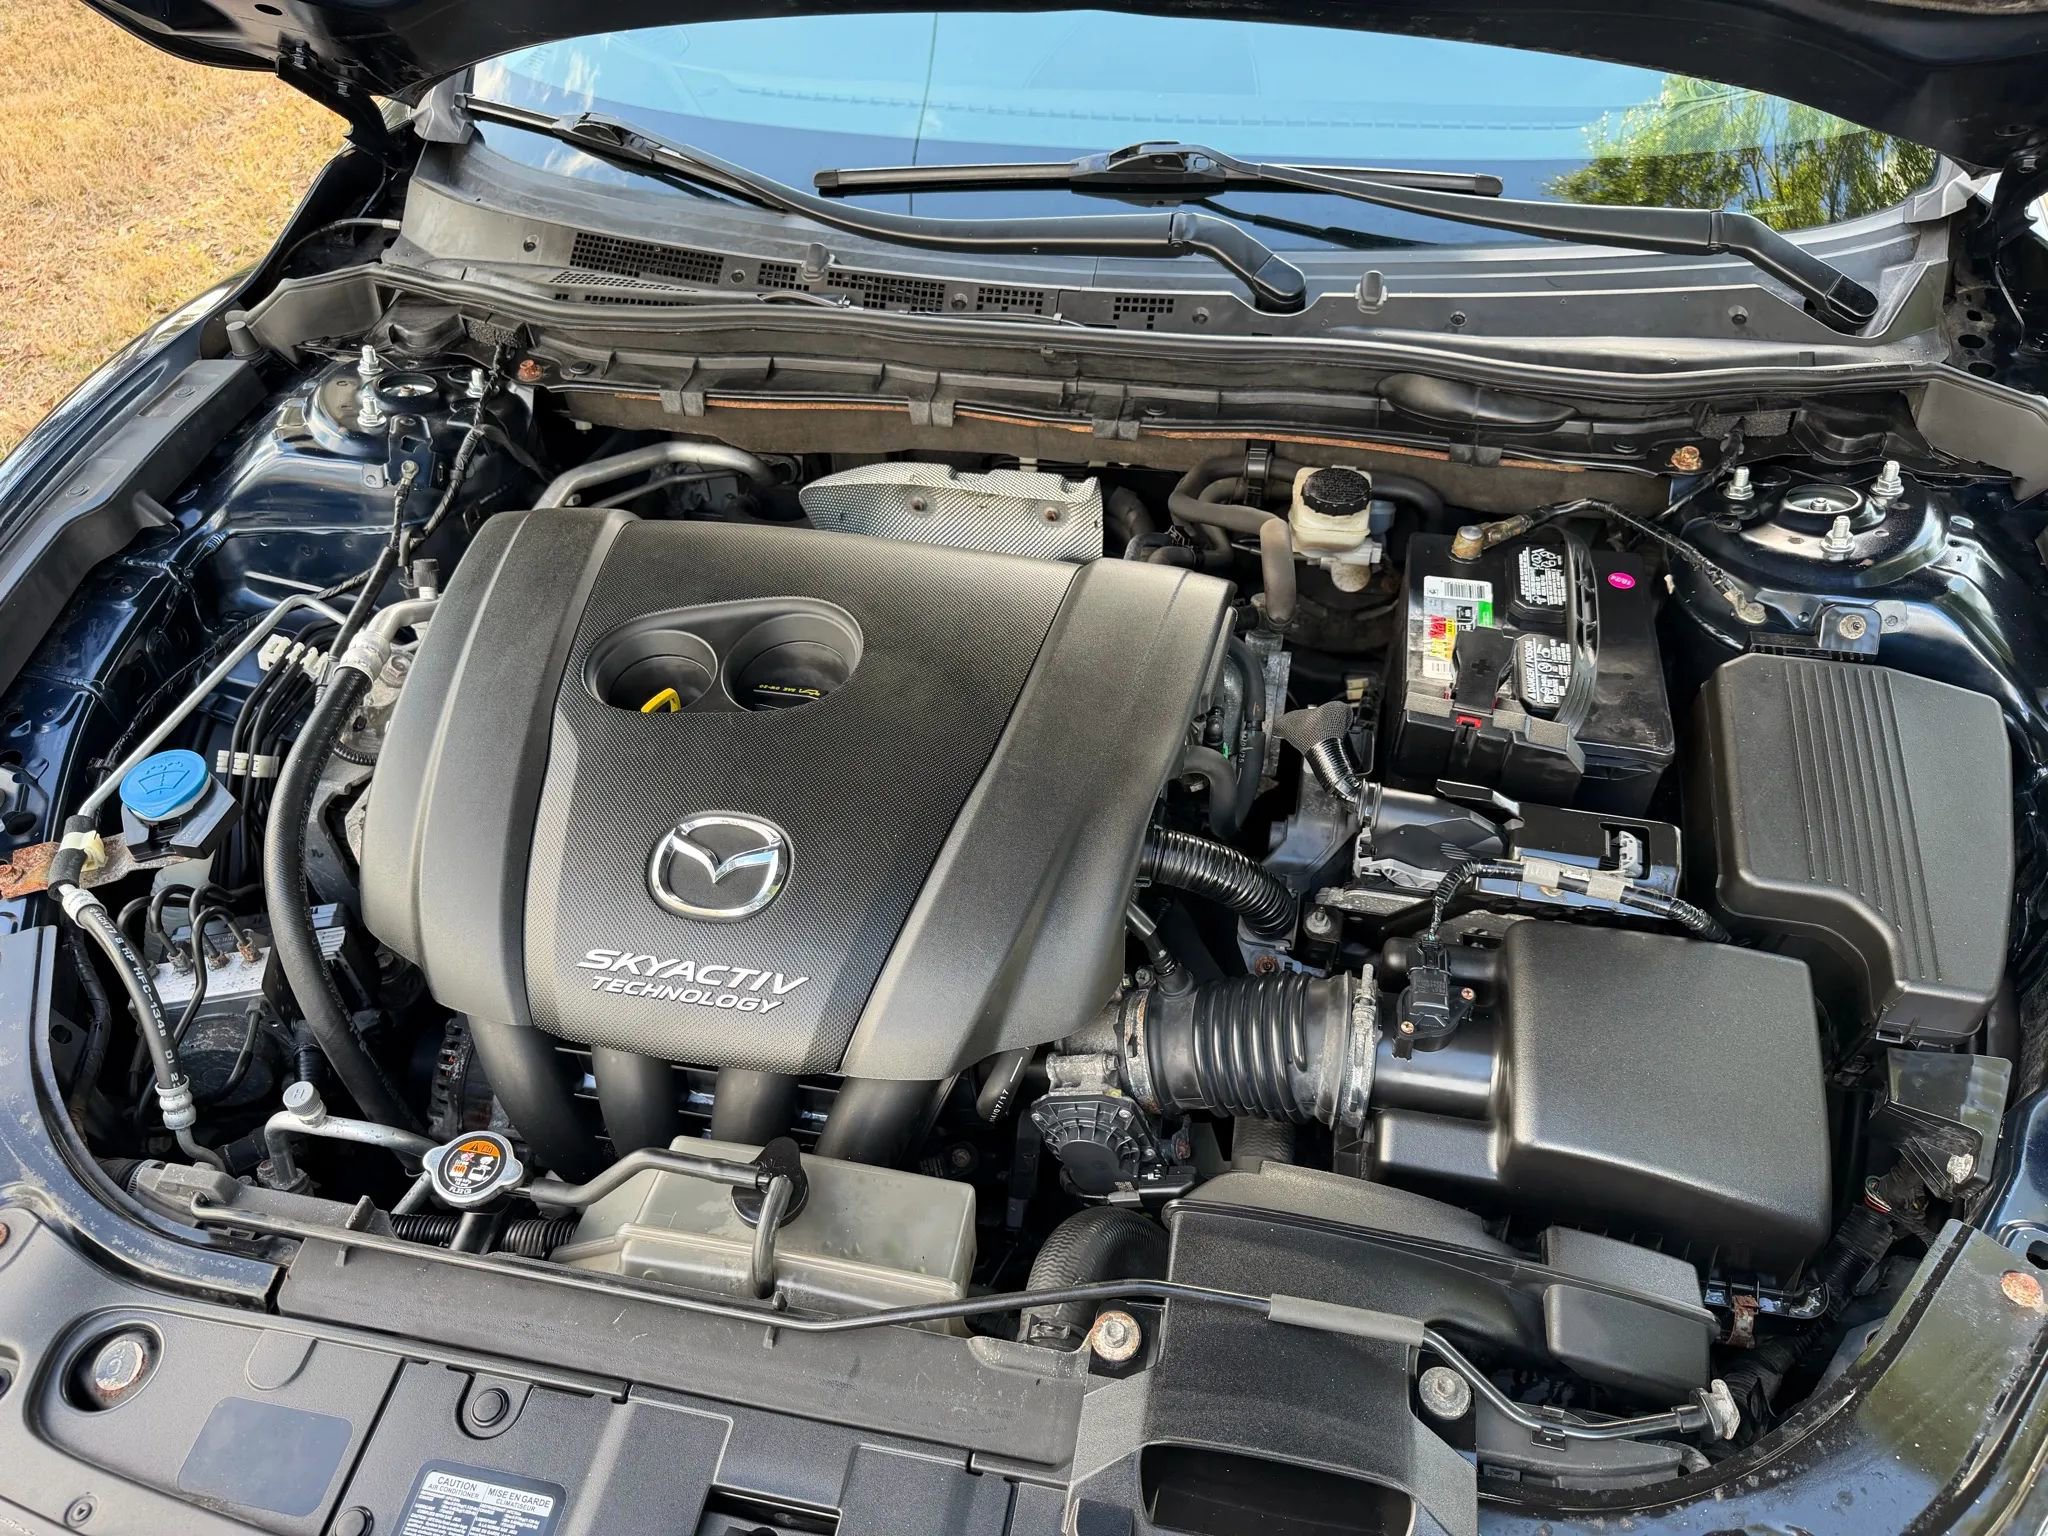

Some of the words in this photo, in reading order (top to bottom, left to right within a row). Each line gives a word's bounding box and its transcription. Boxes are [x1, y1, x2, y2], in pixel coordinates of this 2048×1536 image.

[576, 948, 810, 995] SKYACTIV
[121, 946, 135, 963] HP
[133, 967, 167, 1037] HFC-134a
[591, 975, 784, 1014] TECHNOLOGY
[437, 1476, 477, 1491] CAUTION
[439, 1486, 480, 1499] CONDITIONER
[488, 1487, 509, 1499] MISE
[509, 1491, 521, 1502] EN
[521, 1495, 551, 1508] GARDE
[496, 1498, 536, 1512] CLIMATISEUR
